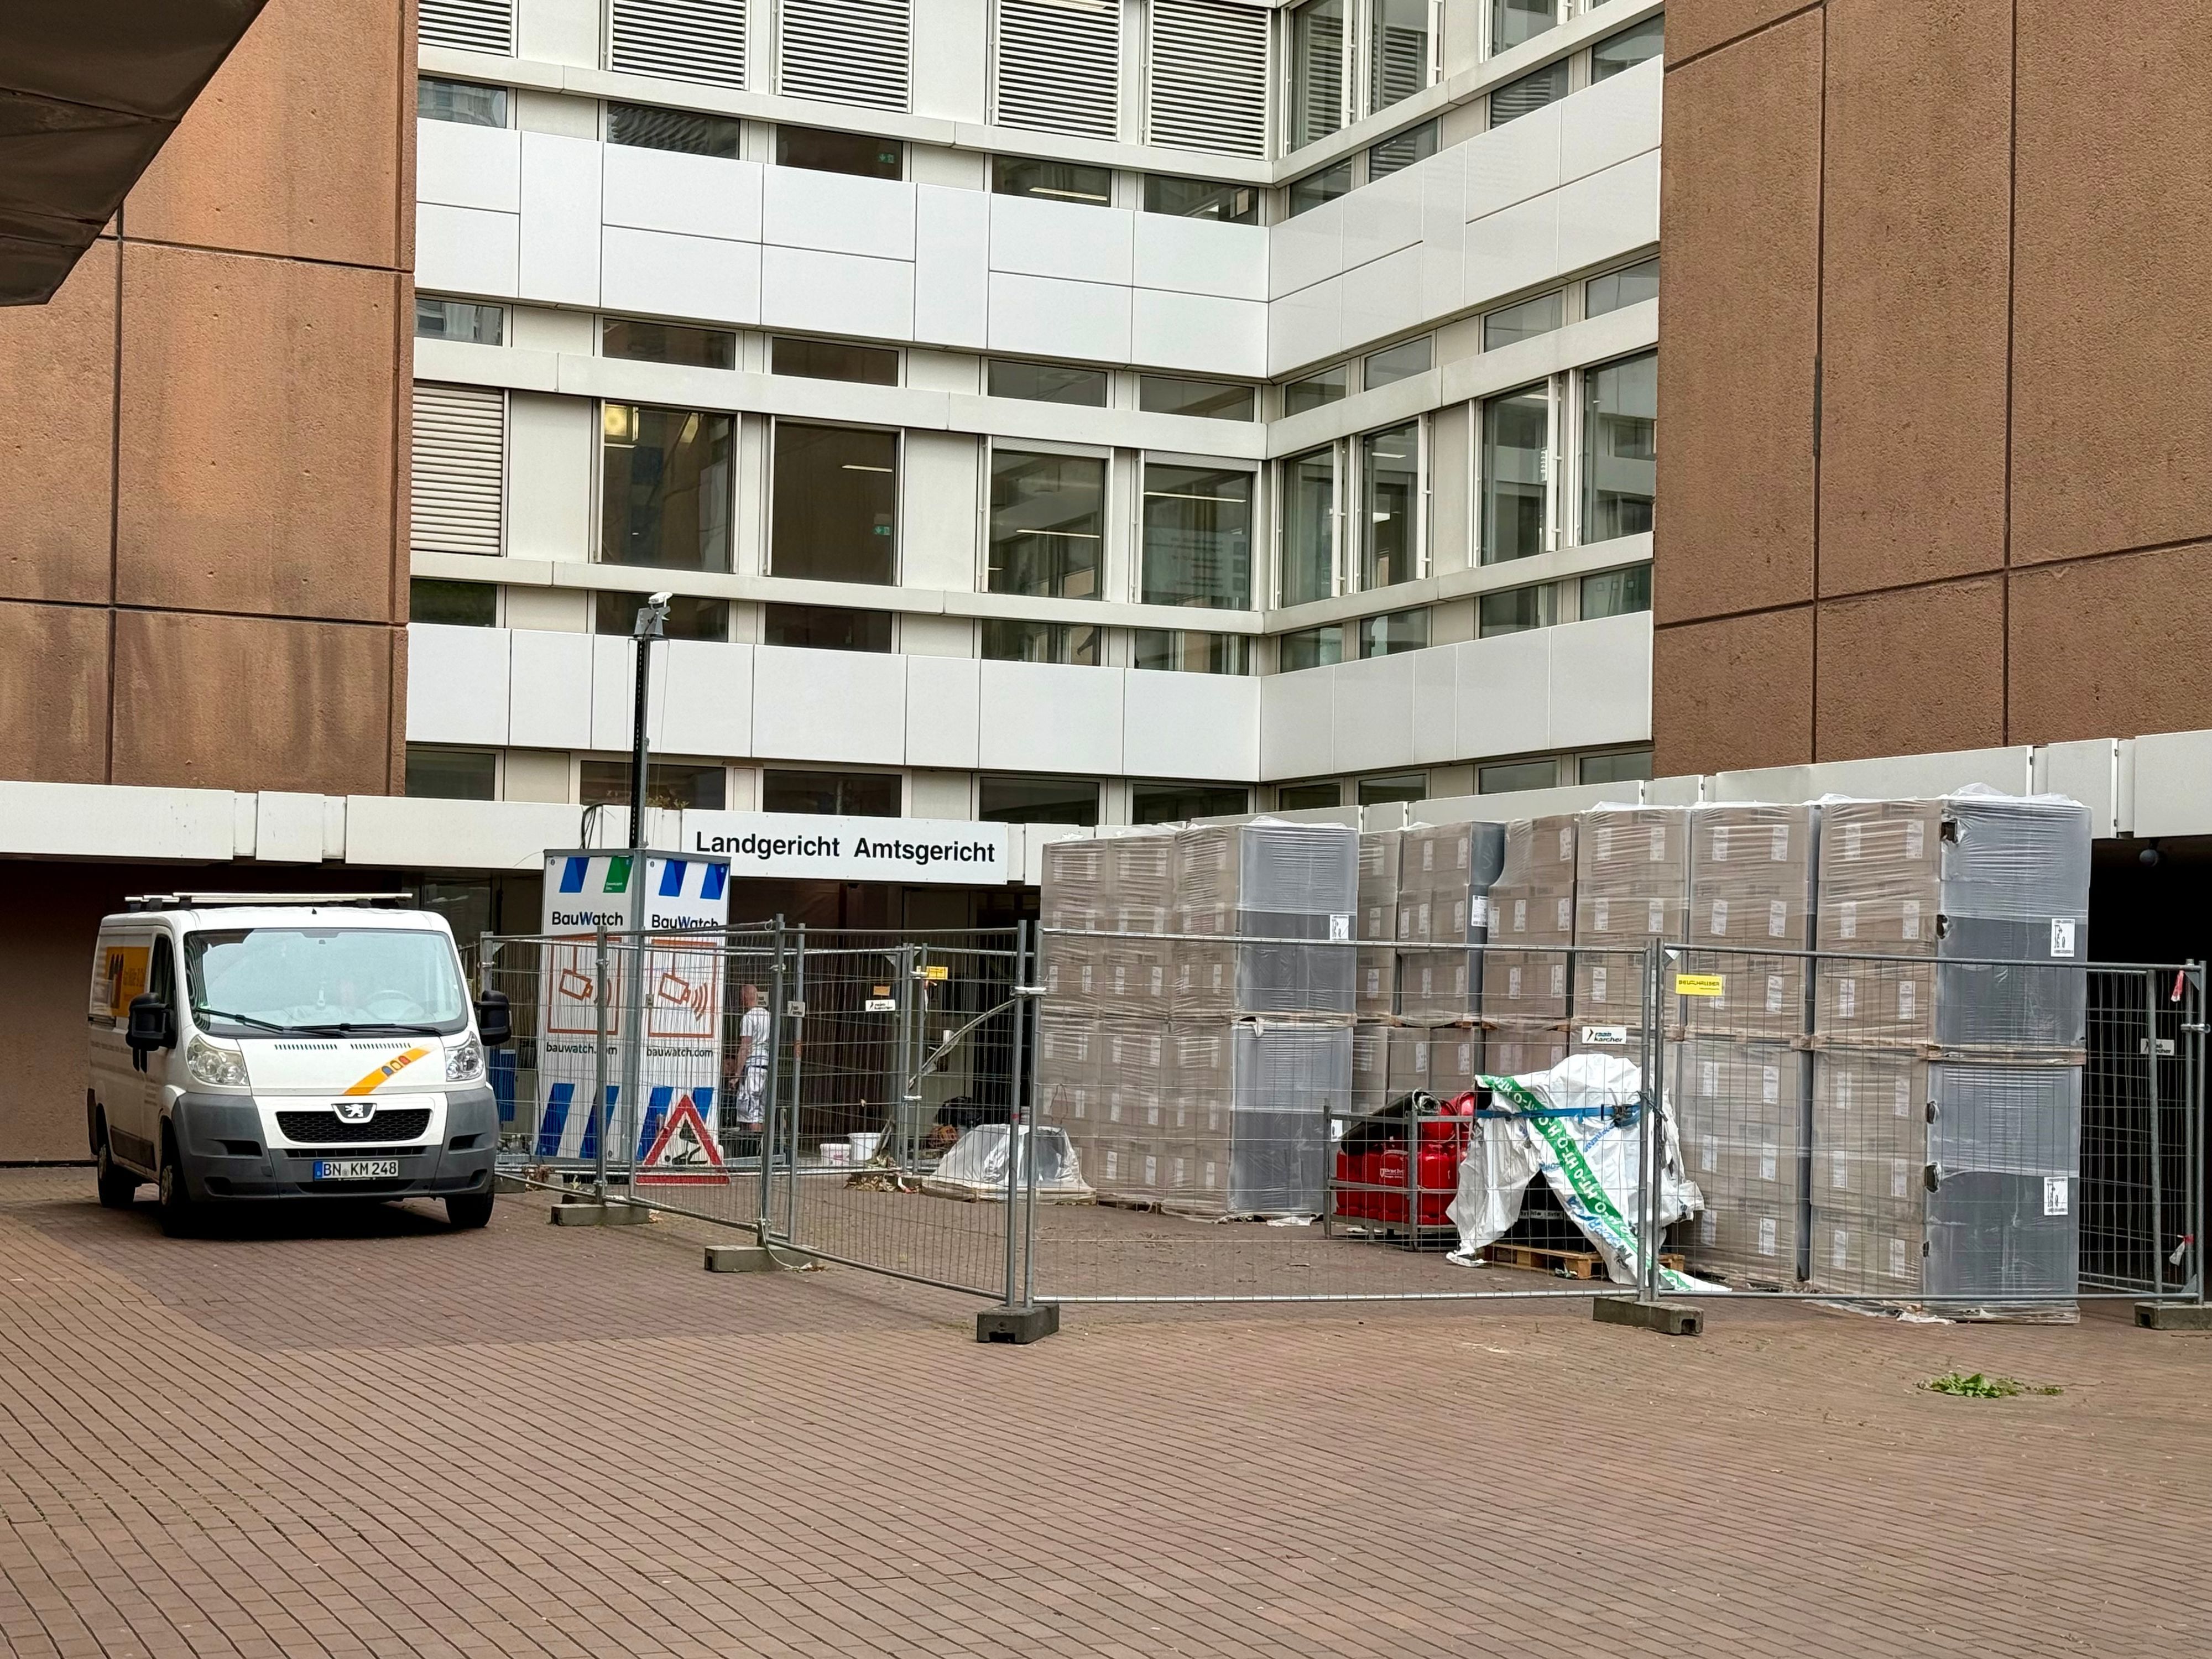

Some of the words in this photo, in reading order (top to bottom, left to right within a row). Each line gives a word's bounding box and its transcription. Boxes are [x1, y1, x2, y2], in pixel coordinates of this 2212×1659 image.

[696, 832, 840, 860] Landgericht
[854, 837, 995, 865] Amtsgericht
[552, 911, 623, 926] BauWatch
[651, 914, 718, 928] BauWatch
[546, 1041, 618, 1055] bauwatch.m
[646, 1046, 713, 1057] bauwatch.com
[1557, 1137, 1579, 1170] HT-O
[323, 1163, 342, 1176] BN
[351, 1162, 369, 1176] KM
[371, 1162, 397, 1175] 248
[1573, 1168, 1598, 1199] HT-O
